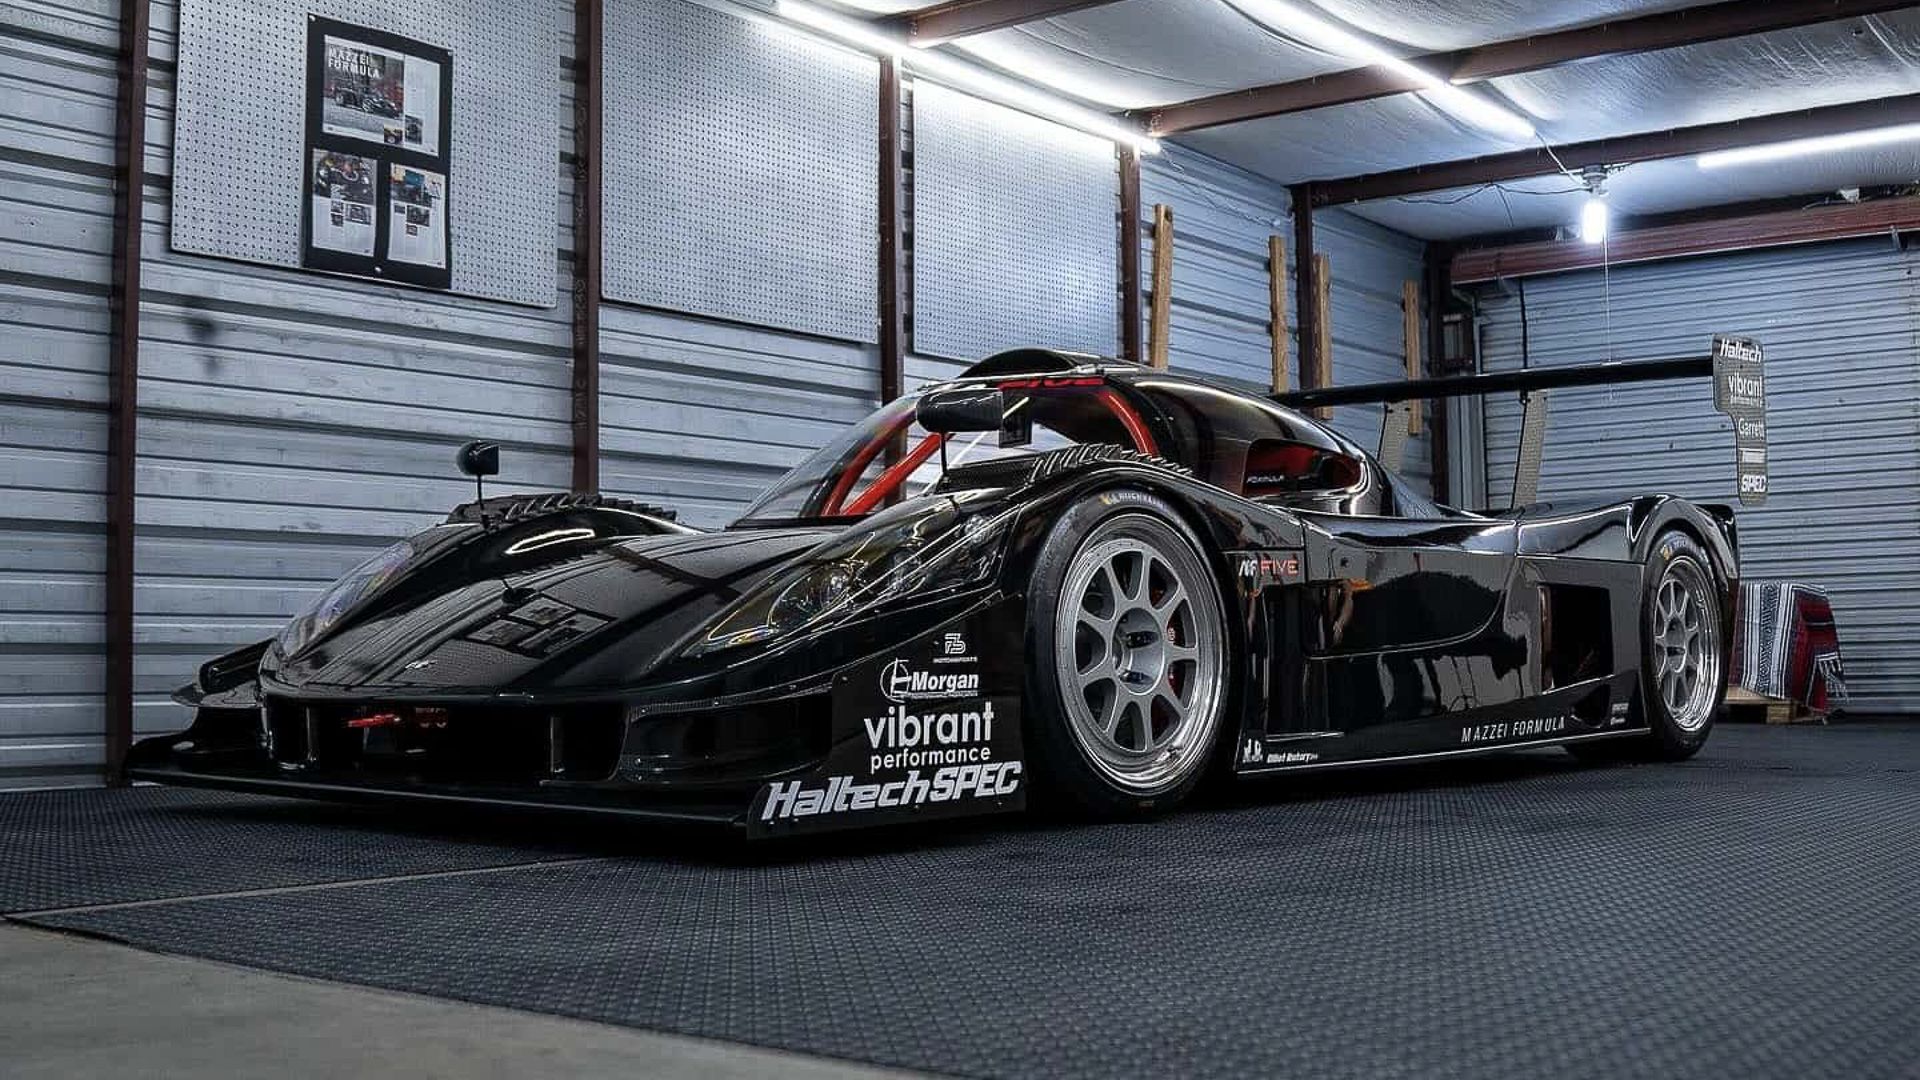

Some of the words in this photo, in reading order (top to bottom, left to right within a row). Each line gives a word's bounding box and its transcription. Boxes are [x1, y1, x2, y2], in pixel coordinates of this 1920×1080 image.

[328, 45, 369, 66] MAZZEI
[327, 57, 381, 79] FORMULA
[1719, 338, 1762, 363] Haltech
[1728, 372, 1763, 397] vibrant
[1740, 474, 1767, 493] SPEC
[1260, 558, 1298, 577] FIVE
[911, 671, 980, 695] Morgan
[863, 701, 995, 749] vibrant
[1460, 723, 1508, 743] MAZZEI
[1512, 716, 1565, 736] FORMULA
[869, 745, 992, 774] performance
